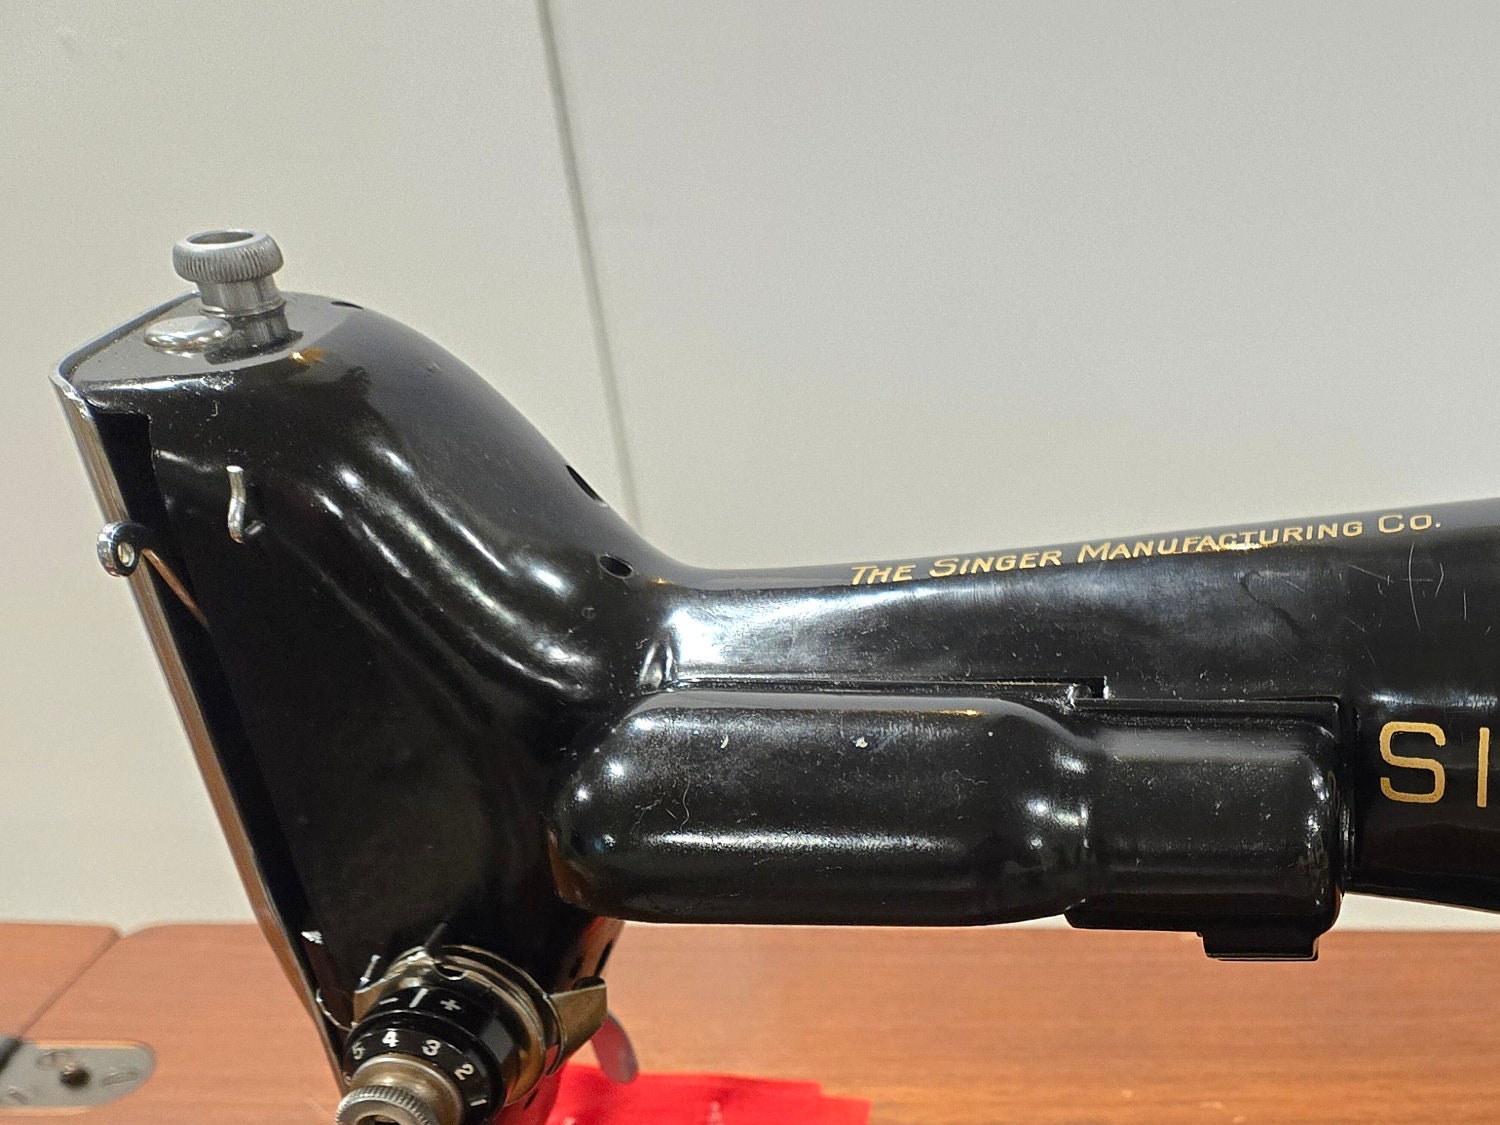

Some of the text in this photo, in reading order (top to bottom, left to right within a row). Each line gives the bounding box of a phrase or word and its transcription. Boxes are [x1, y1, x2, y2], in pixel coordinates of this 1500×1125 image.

[850, 512, 1441, 585] THE SINGER MANUFACTURING CO.
[351, 1040, 365, 1060] 5
[382, 1031, 399, 1048] 4
[422, 1039, 441, 1056] 3
[454, 1063, 474, 1081] 2
